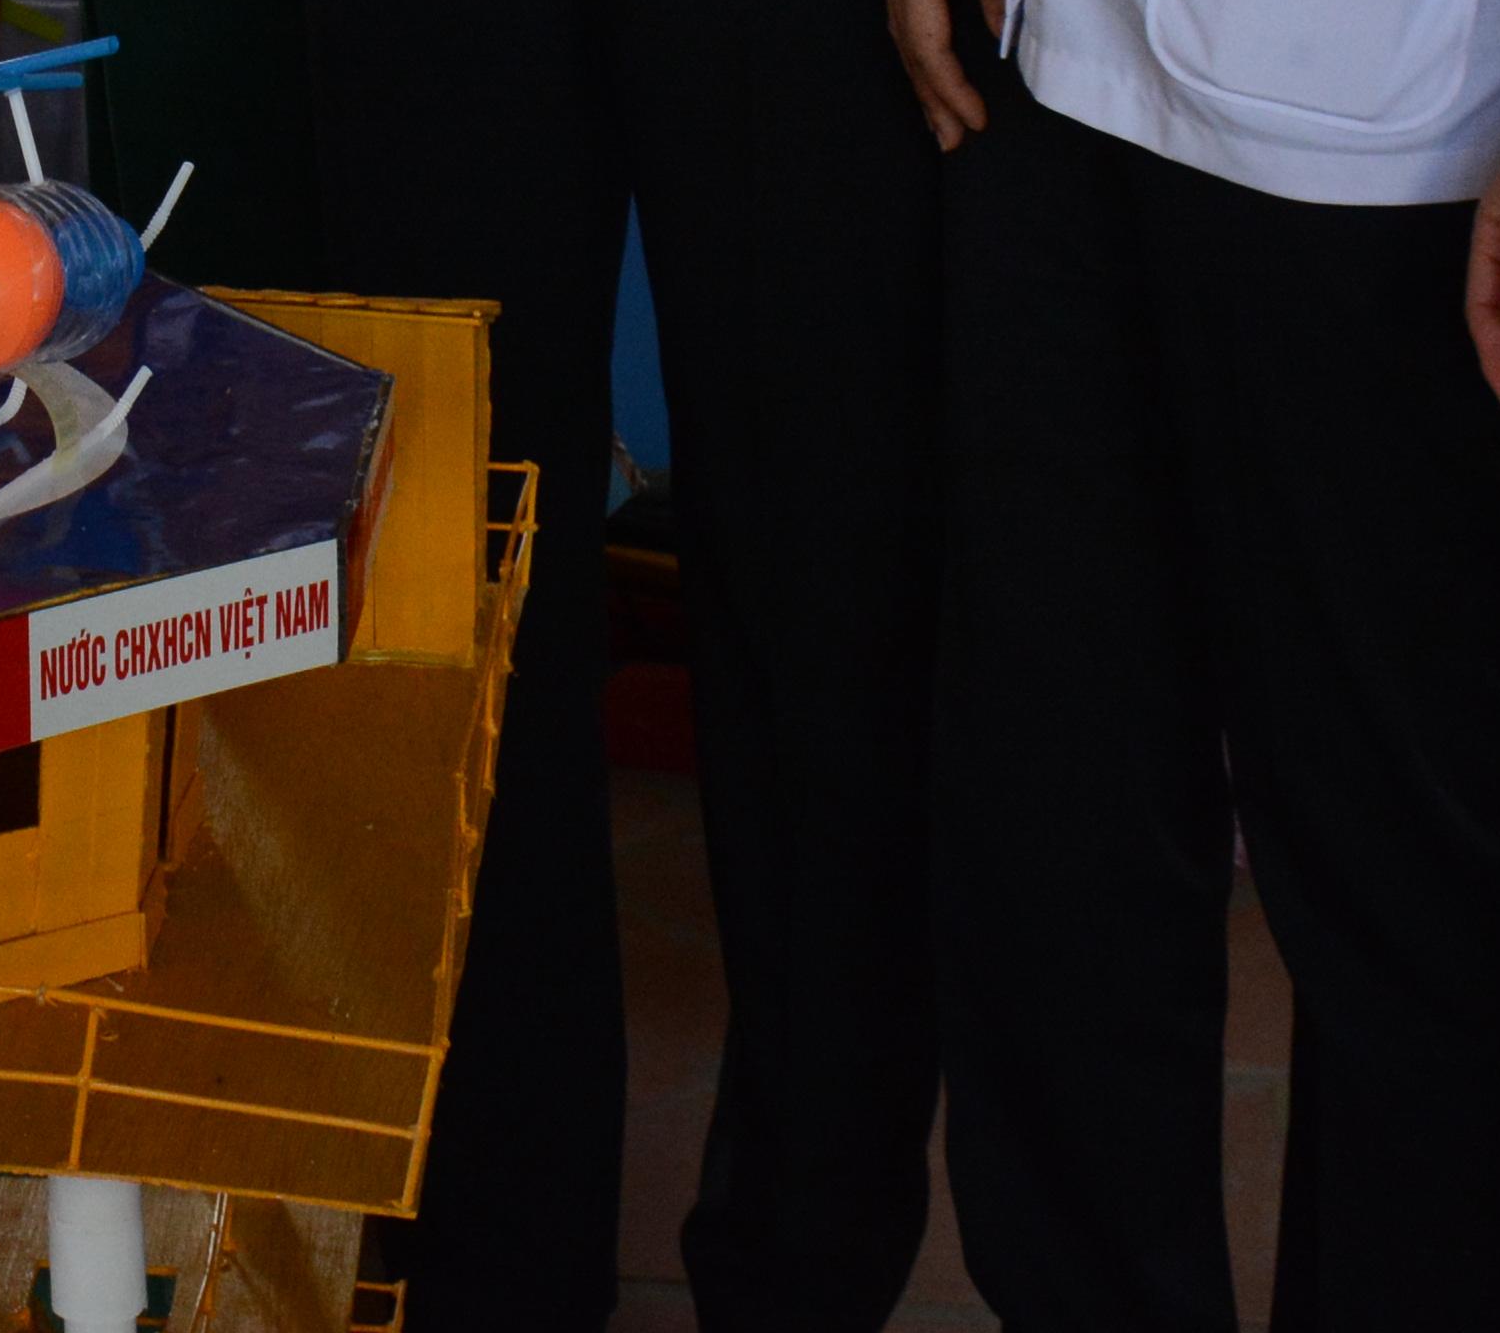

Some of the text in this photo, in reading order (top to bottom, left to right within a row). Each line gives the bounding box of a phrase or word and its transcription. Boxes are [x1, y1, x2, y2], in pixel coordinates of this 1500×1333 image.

[40, 579, 329, 701] NƯỚC CHXHCN VIỆT NAM
